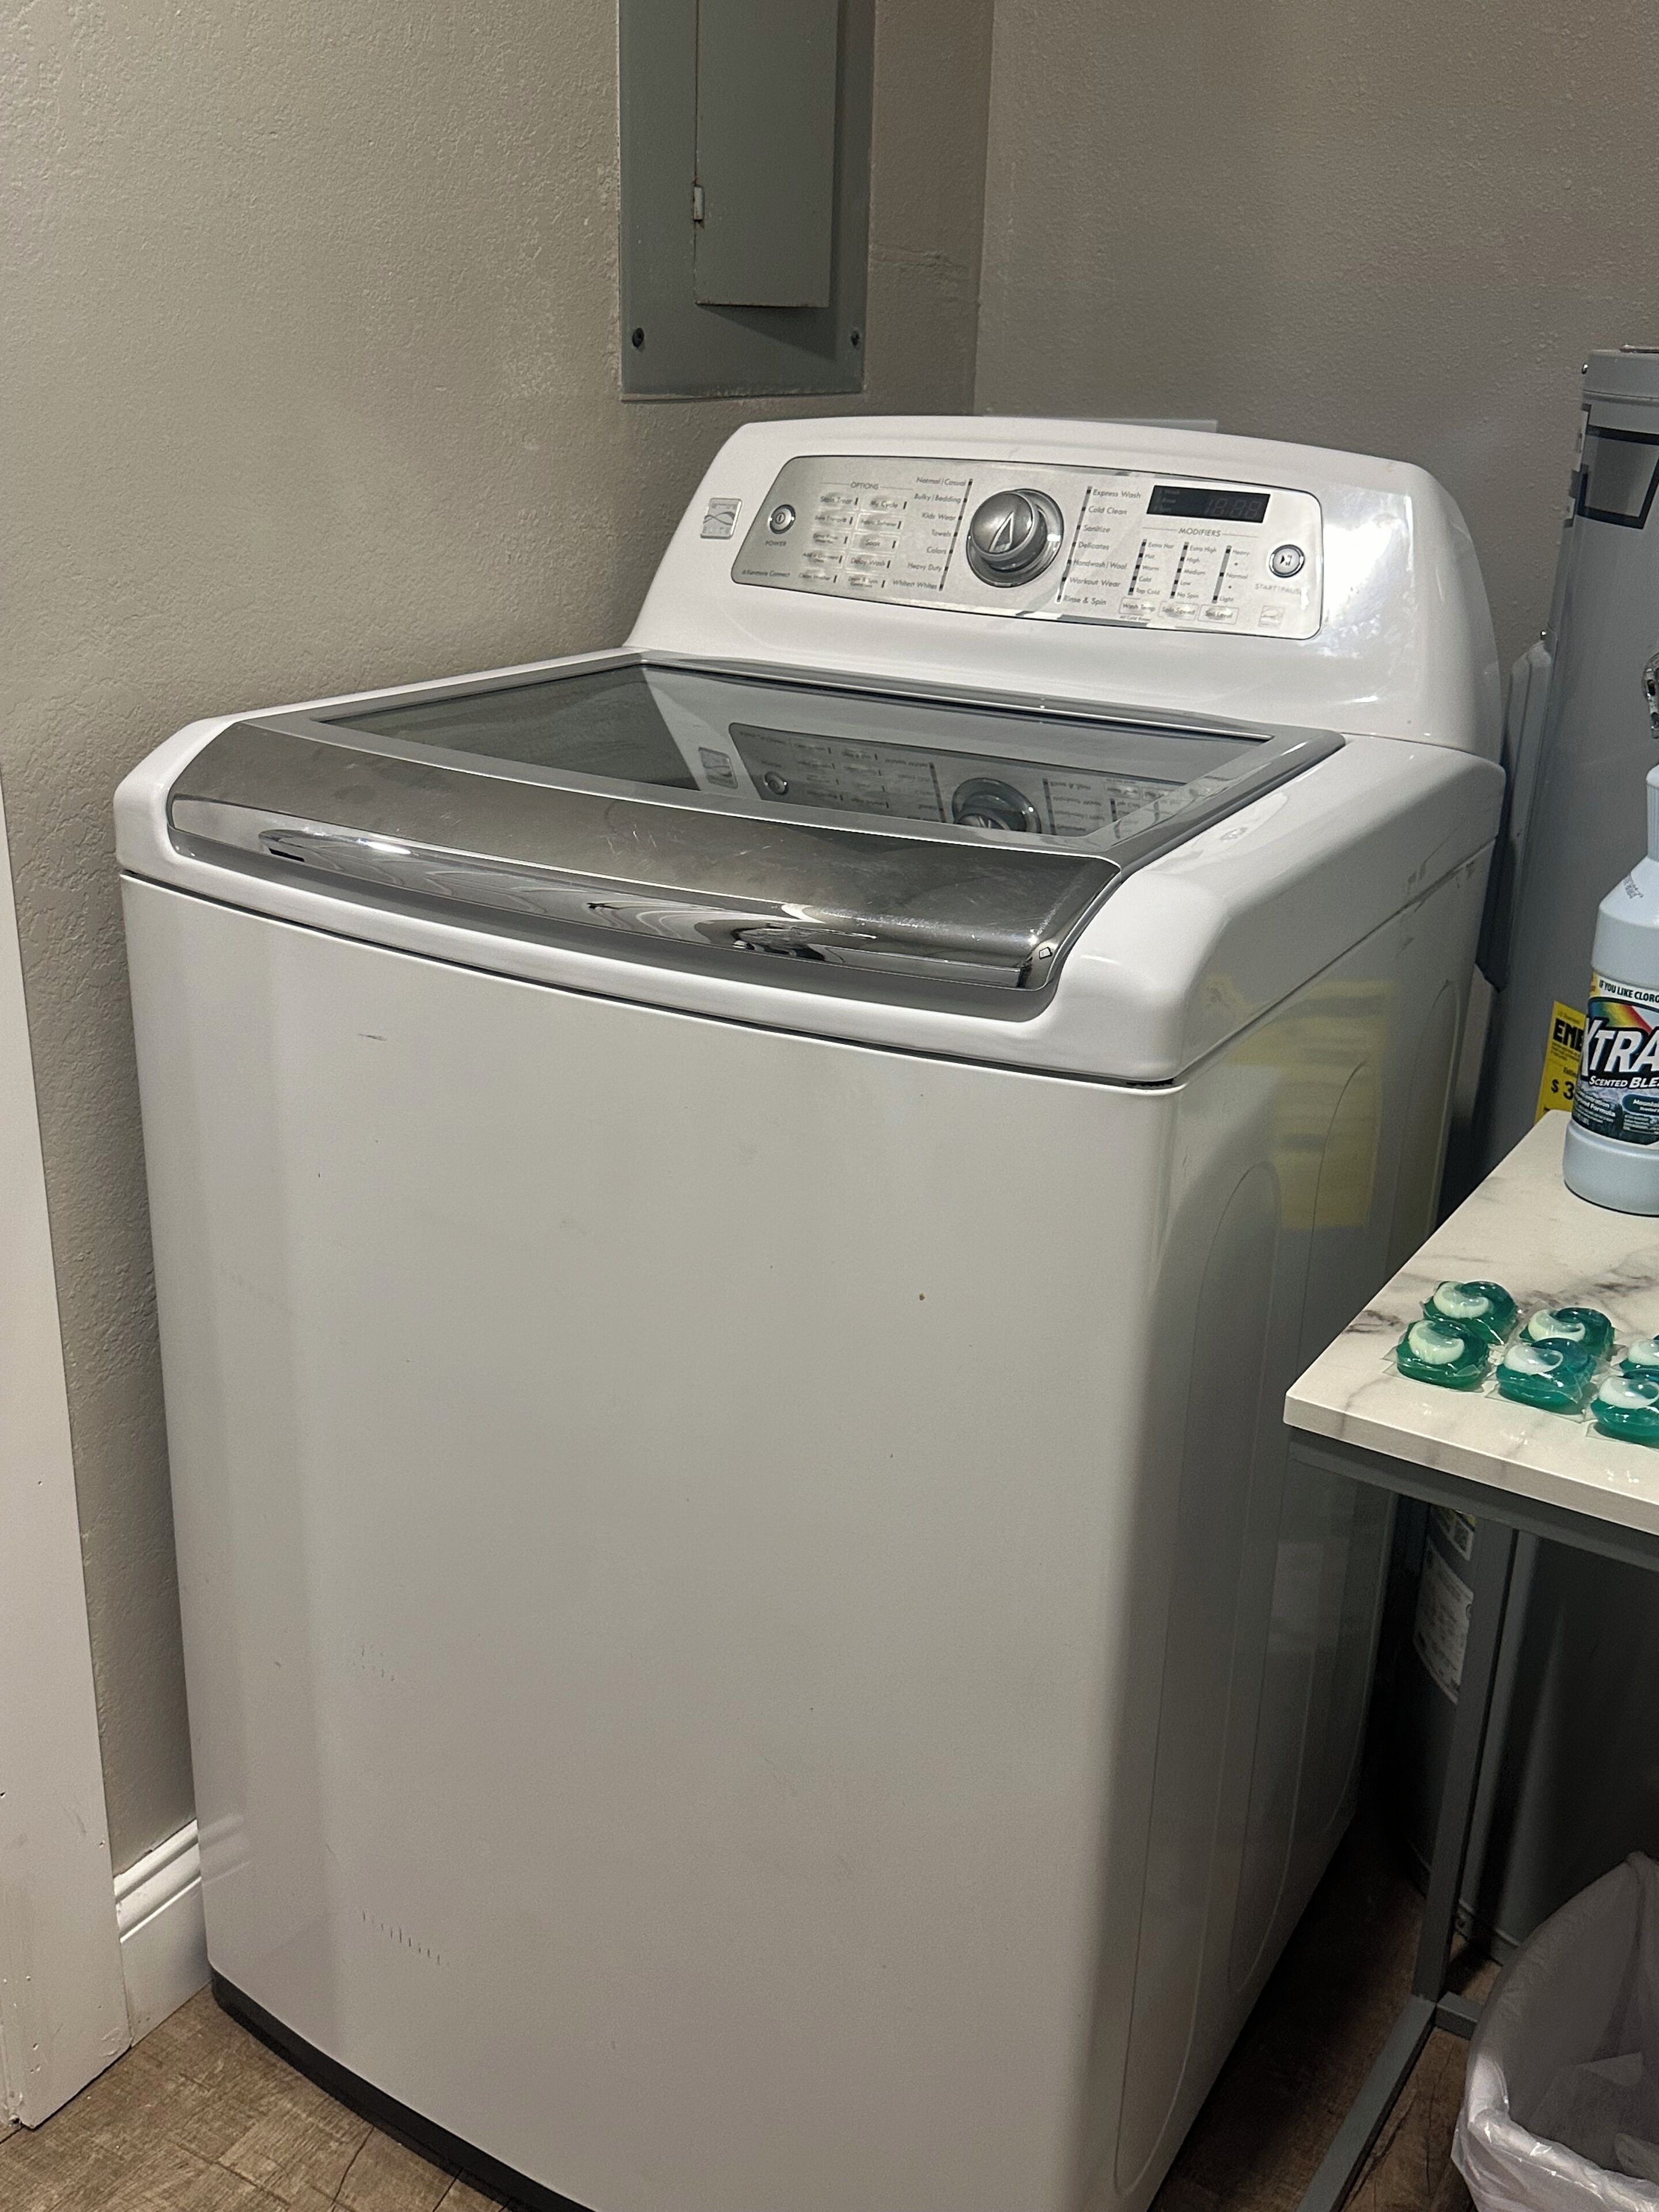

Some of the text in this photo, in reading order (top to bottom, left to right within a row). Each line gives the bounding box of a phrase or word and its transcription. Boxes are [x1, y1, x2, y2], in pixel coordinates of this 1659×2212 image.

[850, 482, 879, 490] OPTIONS
[1093, 489, 1119, 498] Express
[1107, 507, 1127, 515] Clean
[1083, 524, 1111, 533] Sanitize
[1179, 528, 1221, 537] MODIFIERS
[926, 546, 946, 554] Colors
[1078, 541, 1109, 550] Delicates
[928, 564, 942, 572] Duty
[1069, 577, 1121, 588] Workout Wear
[1063, 595, 1081, 603] Rinse
[1091, 597, 1107, 606] Spin
[1140, 604, 1156, 612] Temp
[1176, 607, 1196, 616] Speed
[1604, 982, 1616, 994] YOU
[1617, 987, 1634, 998] LIKE
[1589, 1075, 1628, 1087] SCENTED
